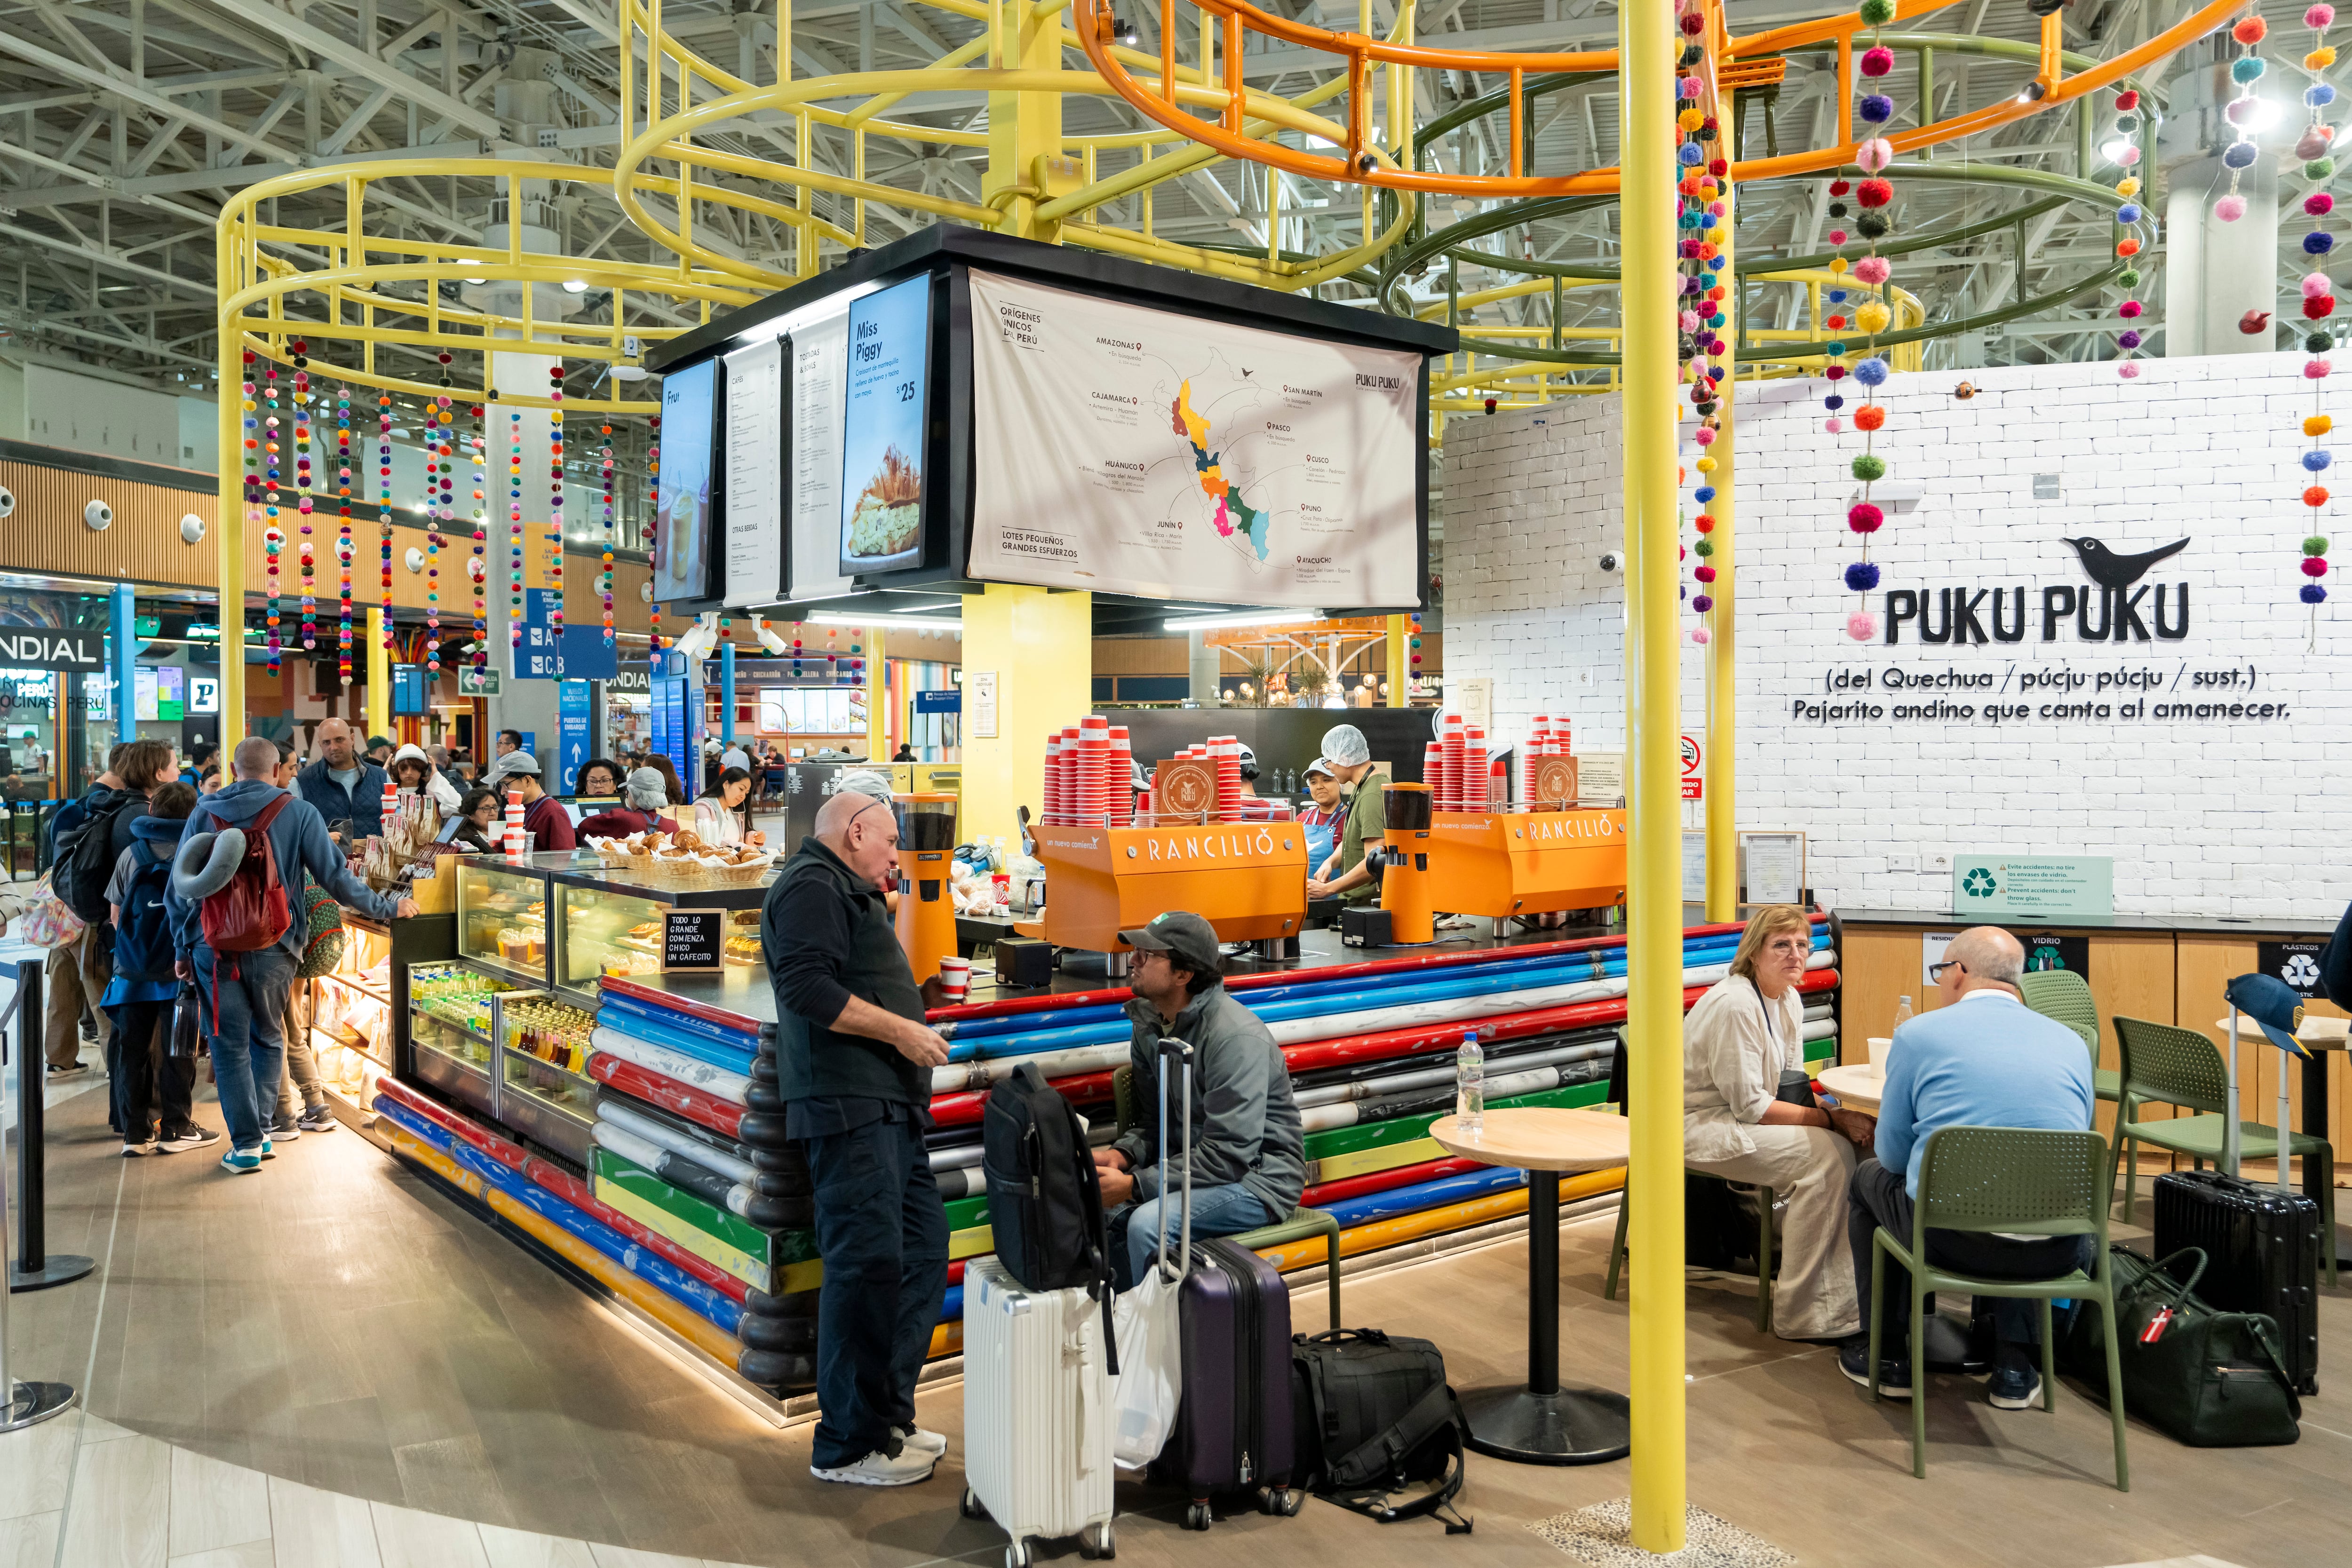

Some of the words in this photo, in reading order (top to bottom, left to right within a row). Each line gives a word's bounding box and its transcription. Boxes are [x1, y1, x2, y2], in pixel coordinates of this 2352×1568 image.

[1001, 307, 1041, 323] ORÍGENES
[857, 320, 877, 341] Miss
[1001, 317, 1032, 332] ÚNICOS
[1017, 333, 1037, 344] PERÚ
[1096, 337, 1135, 350] AMAZONAS
[800, 349, 820, 361] TOSTADAS
[856, 342, 882, 362] Piggy
[1118, 351, 1141, 361] búsqueda
[804, 362, 816, 372] BOWLS
[856, 367, 871, 376] Croissant
[878, 358, 899, 368] mantequilla
[732, 374, 743, 384] CAFÉS
[855, 379, 867, 388] relleno
[1356, 374, 1376, 387] PUKU
[1378, 376, 1399, 389] PUKU
[1092, 392, 1131, 404] CAJAMARCA
[1302, 389, 1322, 398] MARTÍN
[1092, 403, 1113, 412] Artemira
[1292, 397, 1311, 406] búsqueda
[1105, 460, 1137, 470] HUÁNUCO
[744, 523, 757, 532] BEBIDAS
[1157, 520, 1176, 529] JUNÍN
[1003, 531, 1023, 541] LOTES
[1026, 534, 1063, 545] PEQUEÑOS
[1002, 542, 1037, 552] GRANDES
[1040, 547, 1077, 557] ESFUERZOS
[1886, 585, 2025, 645] PUKU
[2043, 582, 2189, 642] PUKU
[1827, 668, 1871, 692] (del
[1882, 667, 1993, 688] Quechua
[2022, 667, 2085, 691] púcju
[2097, 666, 2163, 691] púcju
[2193, 664, 2256, 690] sust.)
[17, 682, 49, 698] PERÚ
[67, 695, 104, 709] PERÚ
[1794, 700, 1883, 723] Pajarito
[1893, 700, 1974, 718] andino
[1984, 704, 2030, 723] que
[2040, 701, 2110, 718] canta
[2121, 697, 2144, 718] al
[2154, 702, 2290, 718] amanecer.
[1529, 817, 1612, 840] RANCILIO
[1072, 840, 1097, 850] comienzo.
[1148, 833, 1273, 860] RANCILIO
